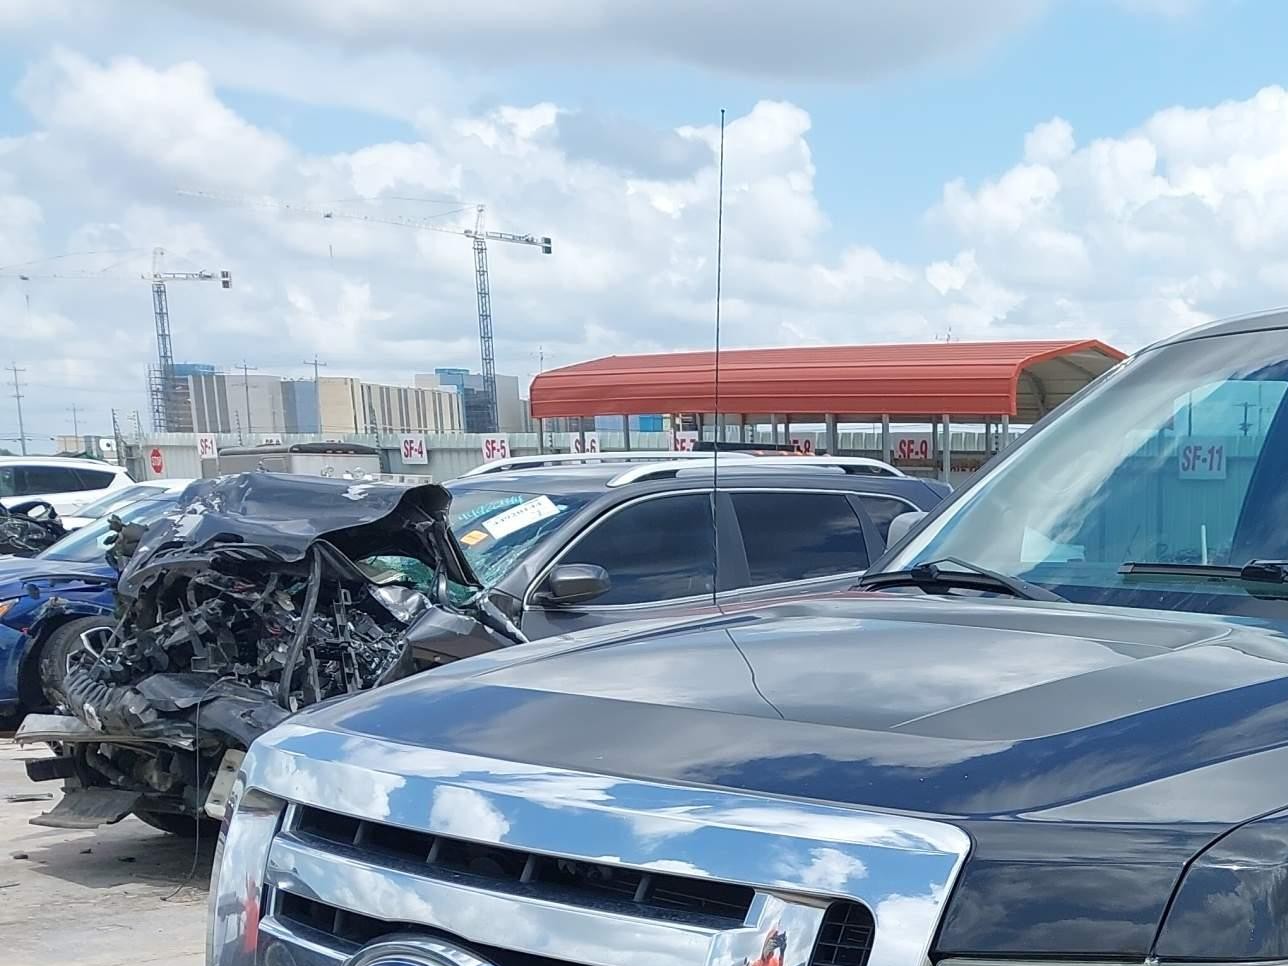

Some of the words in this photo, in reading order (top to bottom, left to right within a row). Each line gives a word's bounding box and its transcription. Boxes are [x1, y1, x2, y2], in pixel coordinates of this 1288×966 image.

[199, 438, 215, 456] SF-1
[403, 439, 424, 459] SF-4
[484, 438, 507, 459] SF-5
[898, 439, 929, 460] SF-9
[1181, 445, 1224, 472] SF-11
